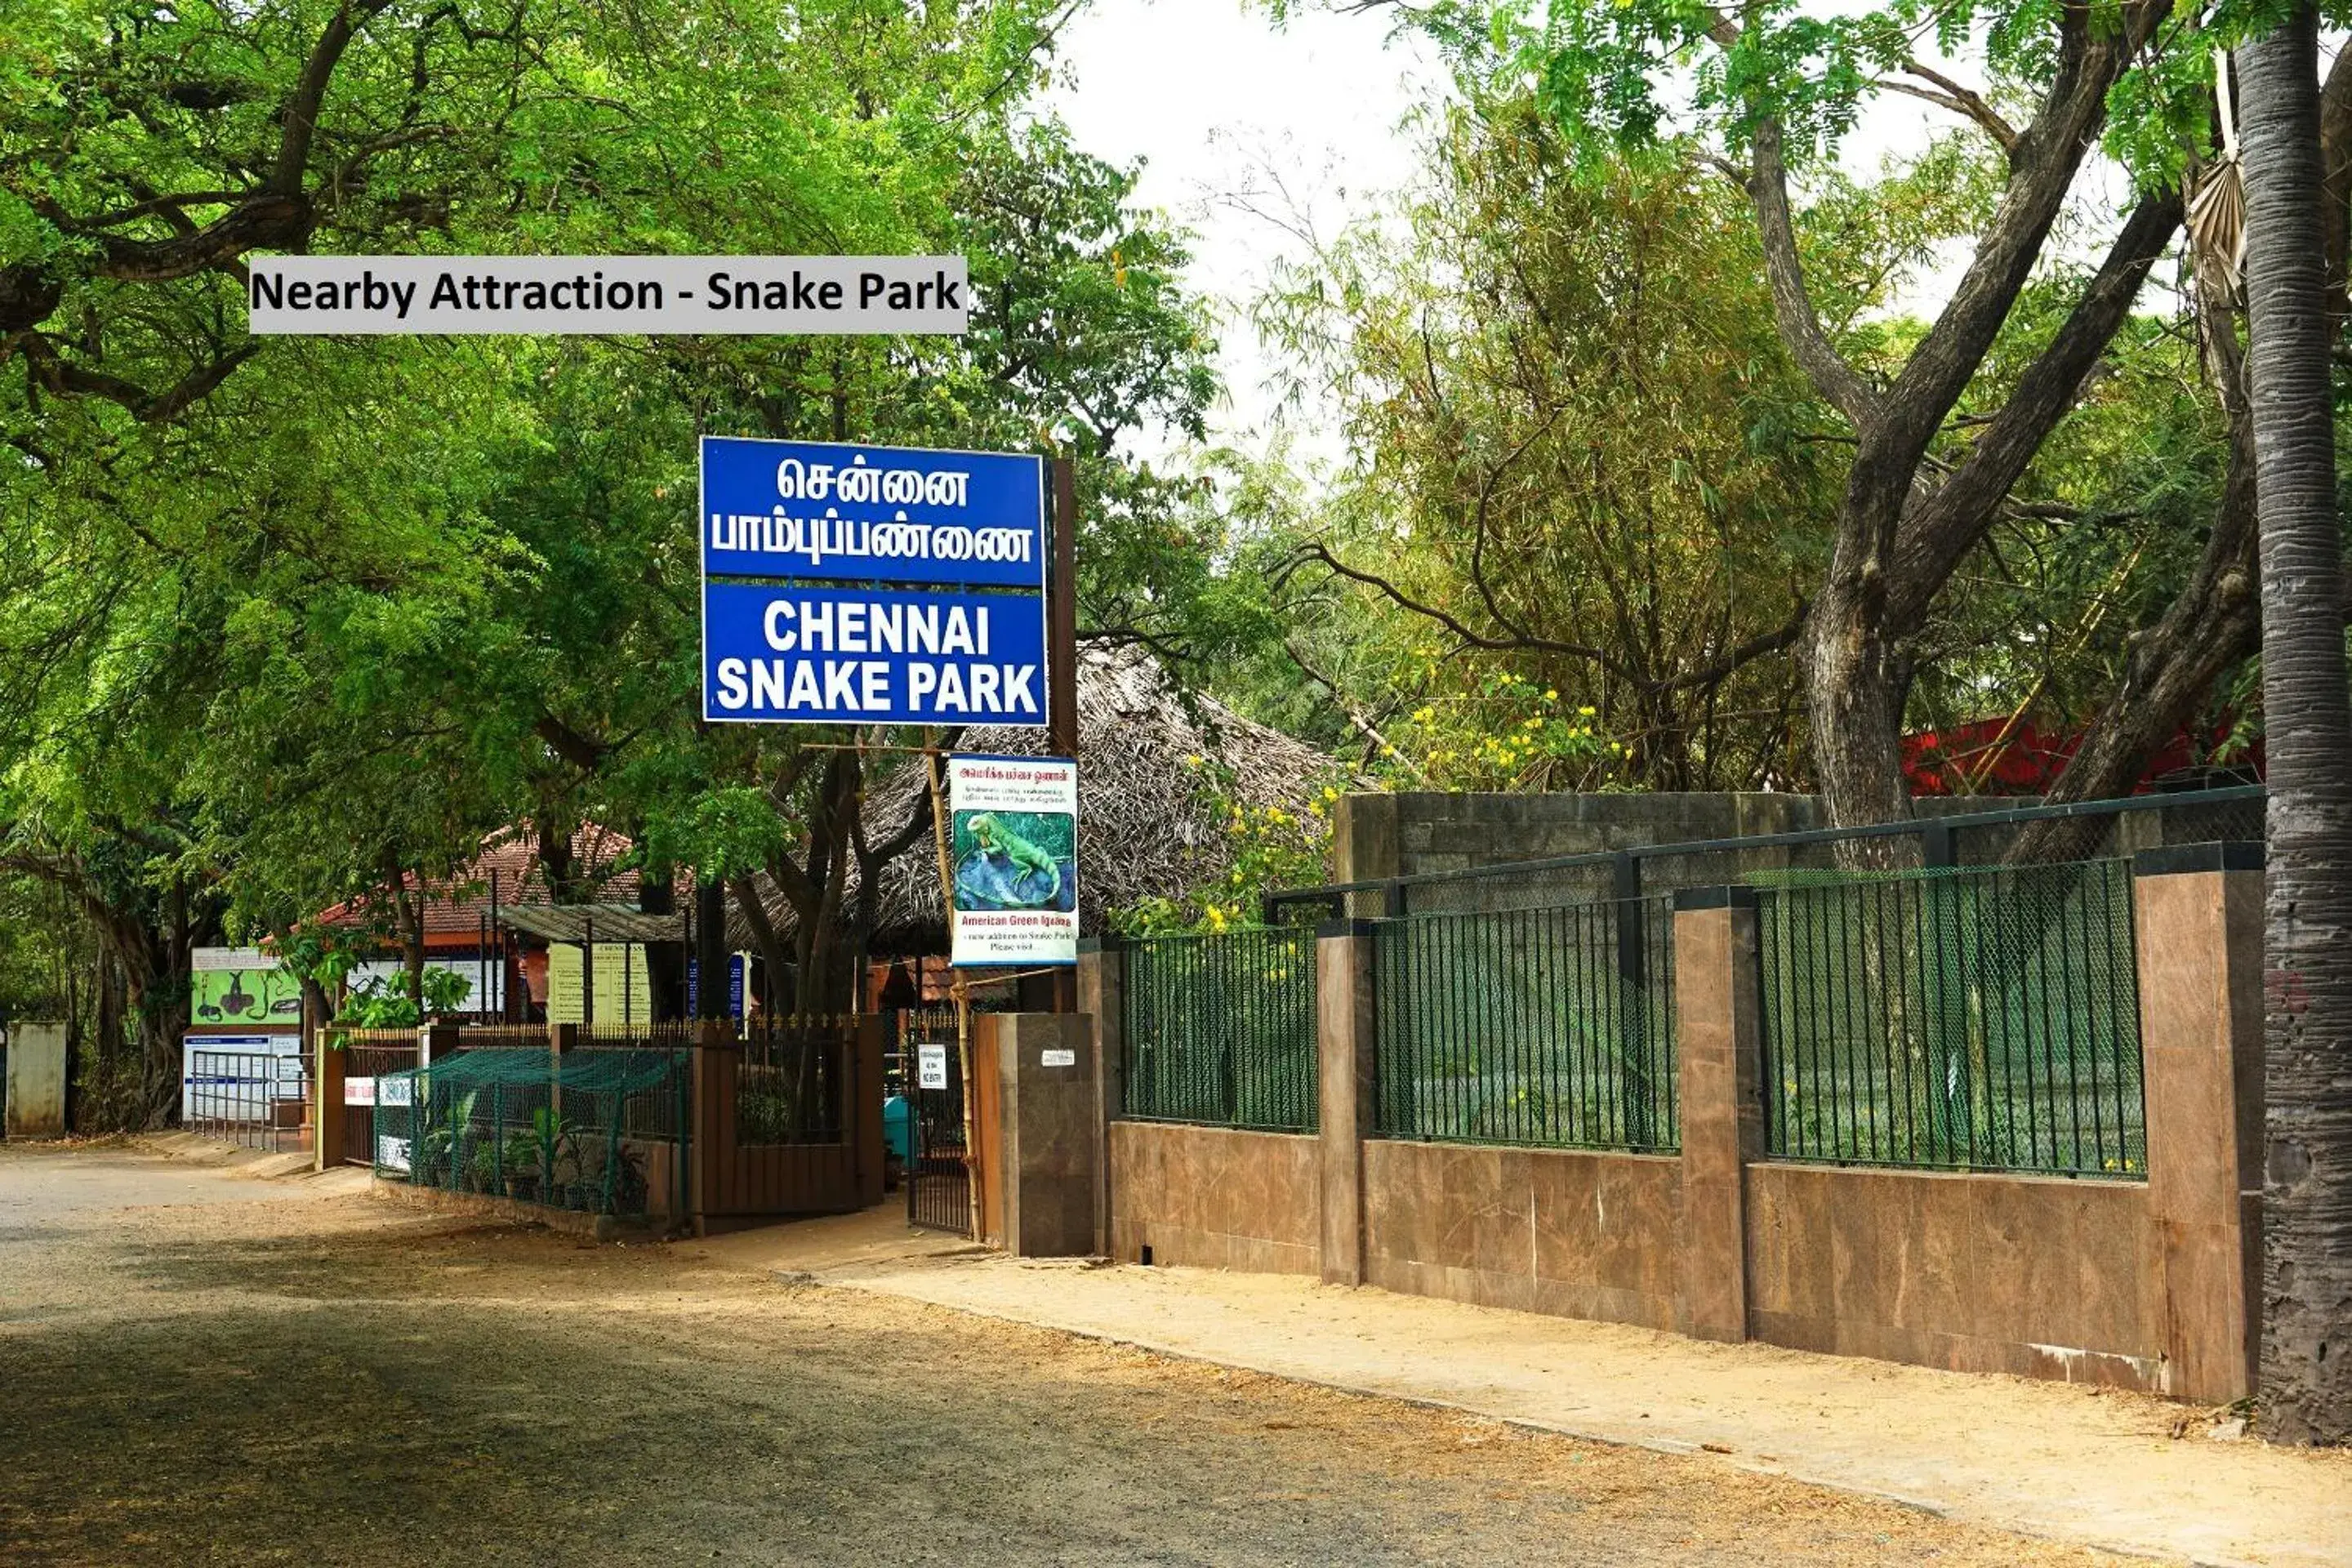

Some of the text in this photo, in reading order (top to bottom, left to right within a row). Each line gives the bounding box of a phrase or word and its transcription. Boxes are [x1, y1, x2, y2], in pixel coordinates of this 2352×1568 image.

[777, 453, 969, 507] சென்னை
[711, 504, 1034, 565] பாம்புப்பண்ணை
[764, 599, 990, 656] CHENNAI
[716, 657, 1039, 714] SNAKE PARK
[962, 915, 1007, 926] American
[1009, 915, 1038, 926] Green
[990, 942, 1014, 951] Please
